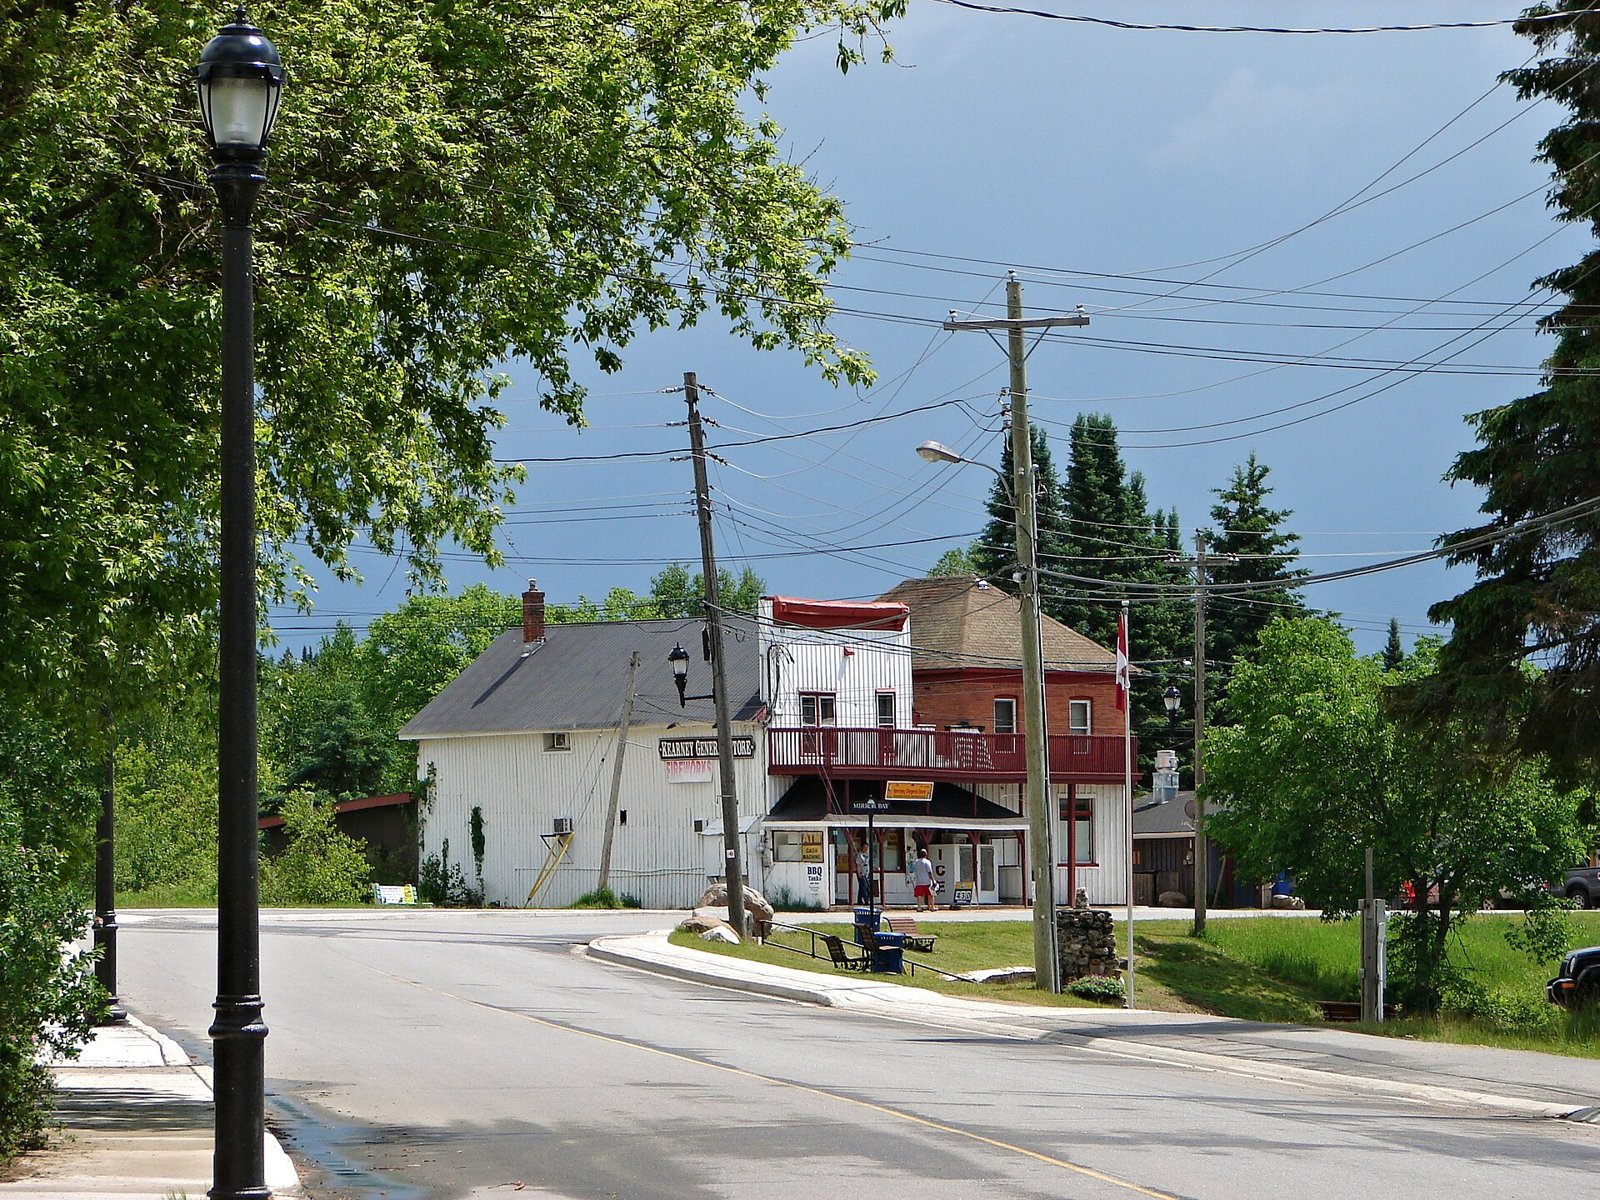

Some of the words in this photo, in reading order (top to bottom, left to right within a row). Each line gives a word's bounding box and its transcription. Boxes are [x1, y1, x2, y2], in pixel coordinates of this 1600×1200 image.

[661, 741, 694, 757] KEARNEY
[695, 740, 720, 756] GENER
[732, 740, 752, 755] TORE
[665, 761, 712, 776] FIREWORKS
[807, 866, 823, 876] BBQ
